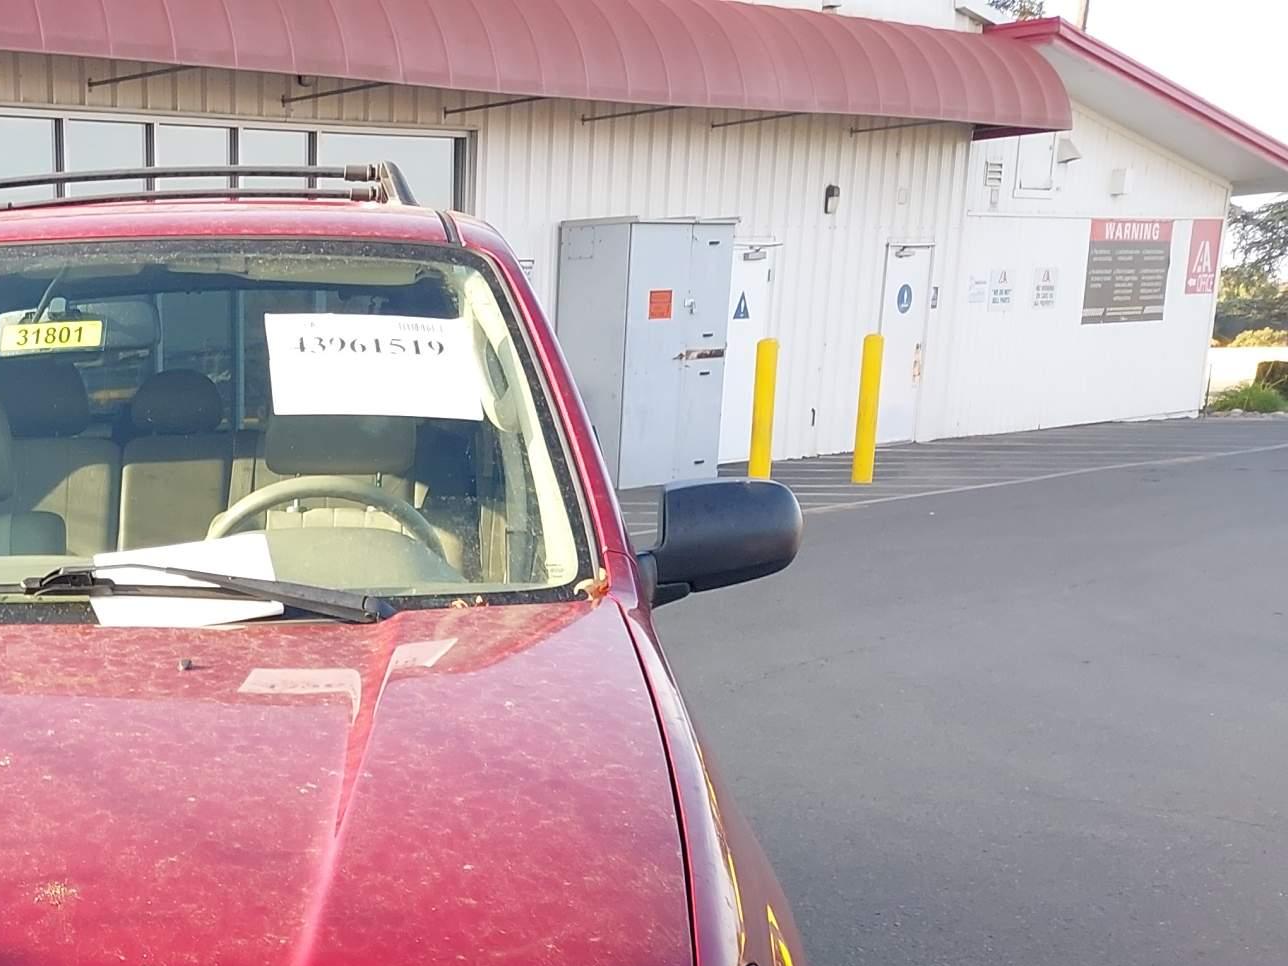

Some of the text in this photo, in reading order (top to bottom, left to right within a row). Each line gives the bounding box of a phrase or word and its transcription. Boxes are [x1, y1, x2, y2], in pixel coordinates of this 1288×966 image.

[1105, 222, 1160, 240] WARNING
[16, 326, 83, 346] 31801
[294, 336, 445, 356] 43961519
